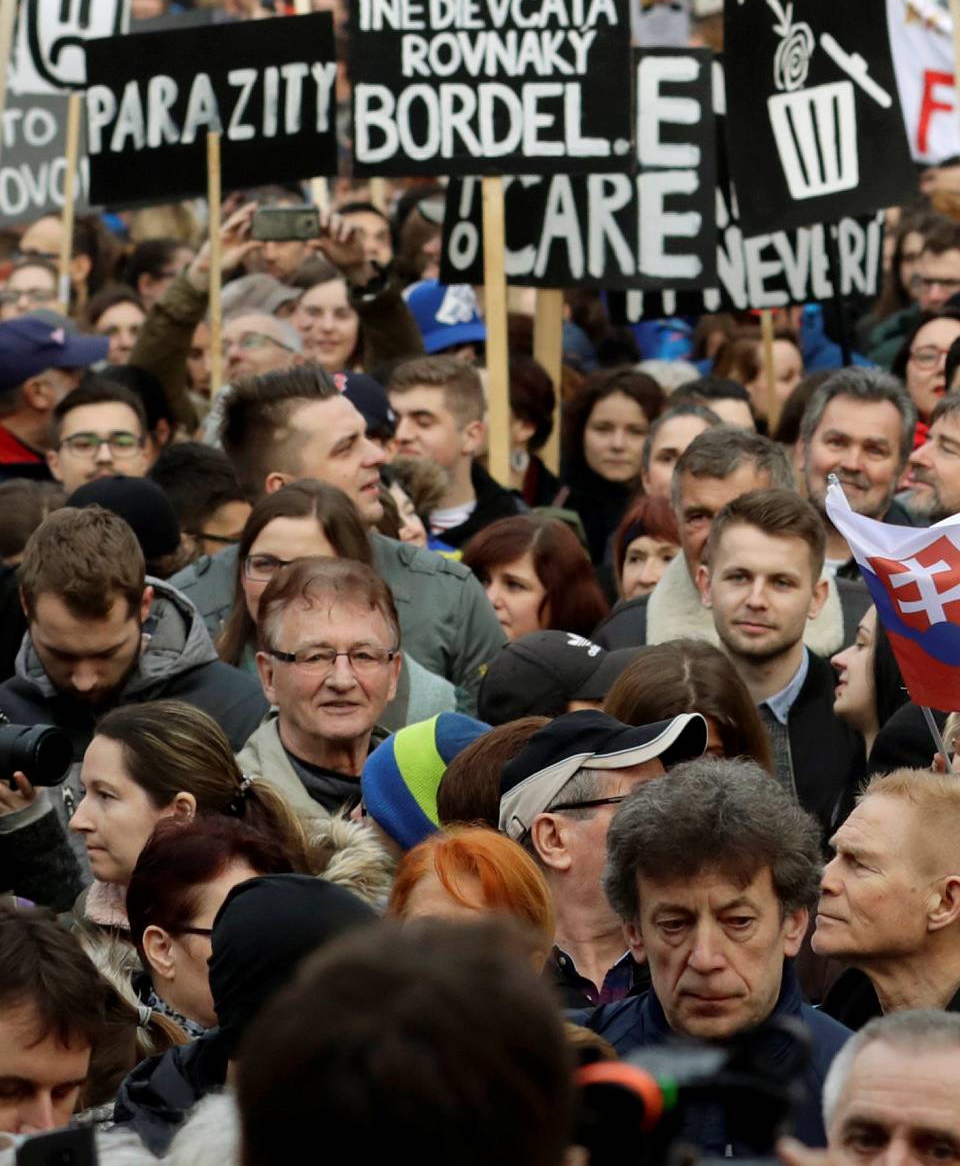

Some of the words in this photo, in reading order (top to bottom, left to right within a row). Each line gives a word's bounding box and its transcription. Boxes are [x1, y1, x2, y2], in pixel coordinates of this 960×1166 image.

[401, 23, 598, 77] ROVNAKÝ
[86, 62, 338, 155] PARAZITY
[354, 82, 631, 164] BORDEL.
